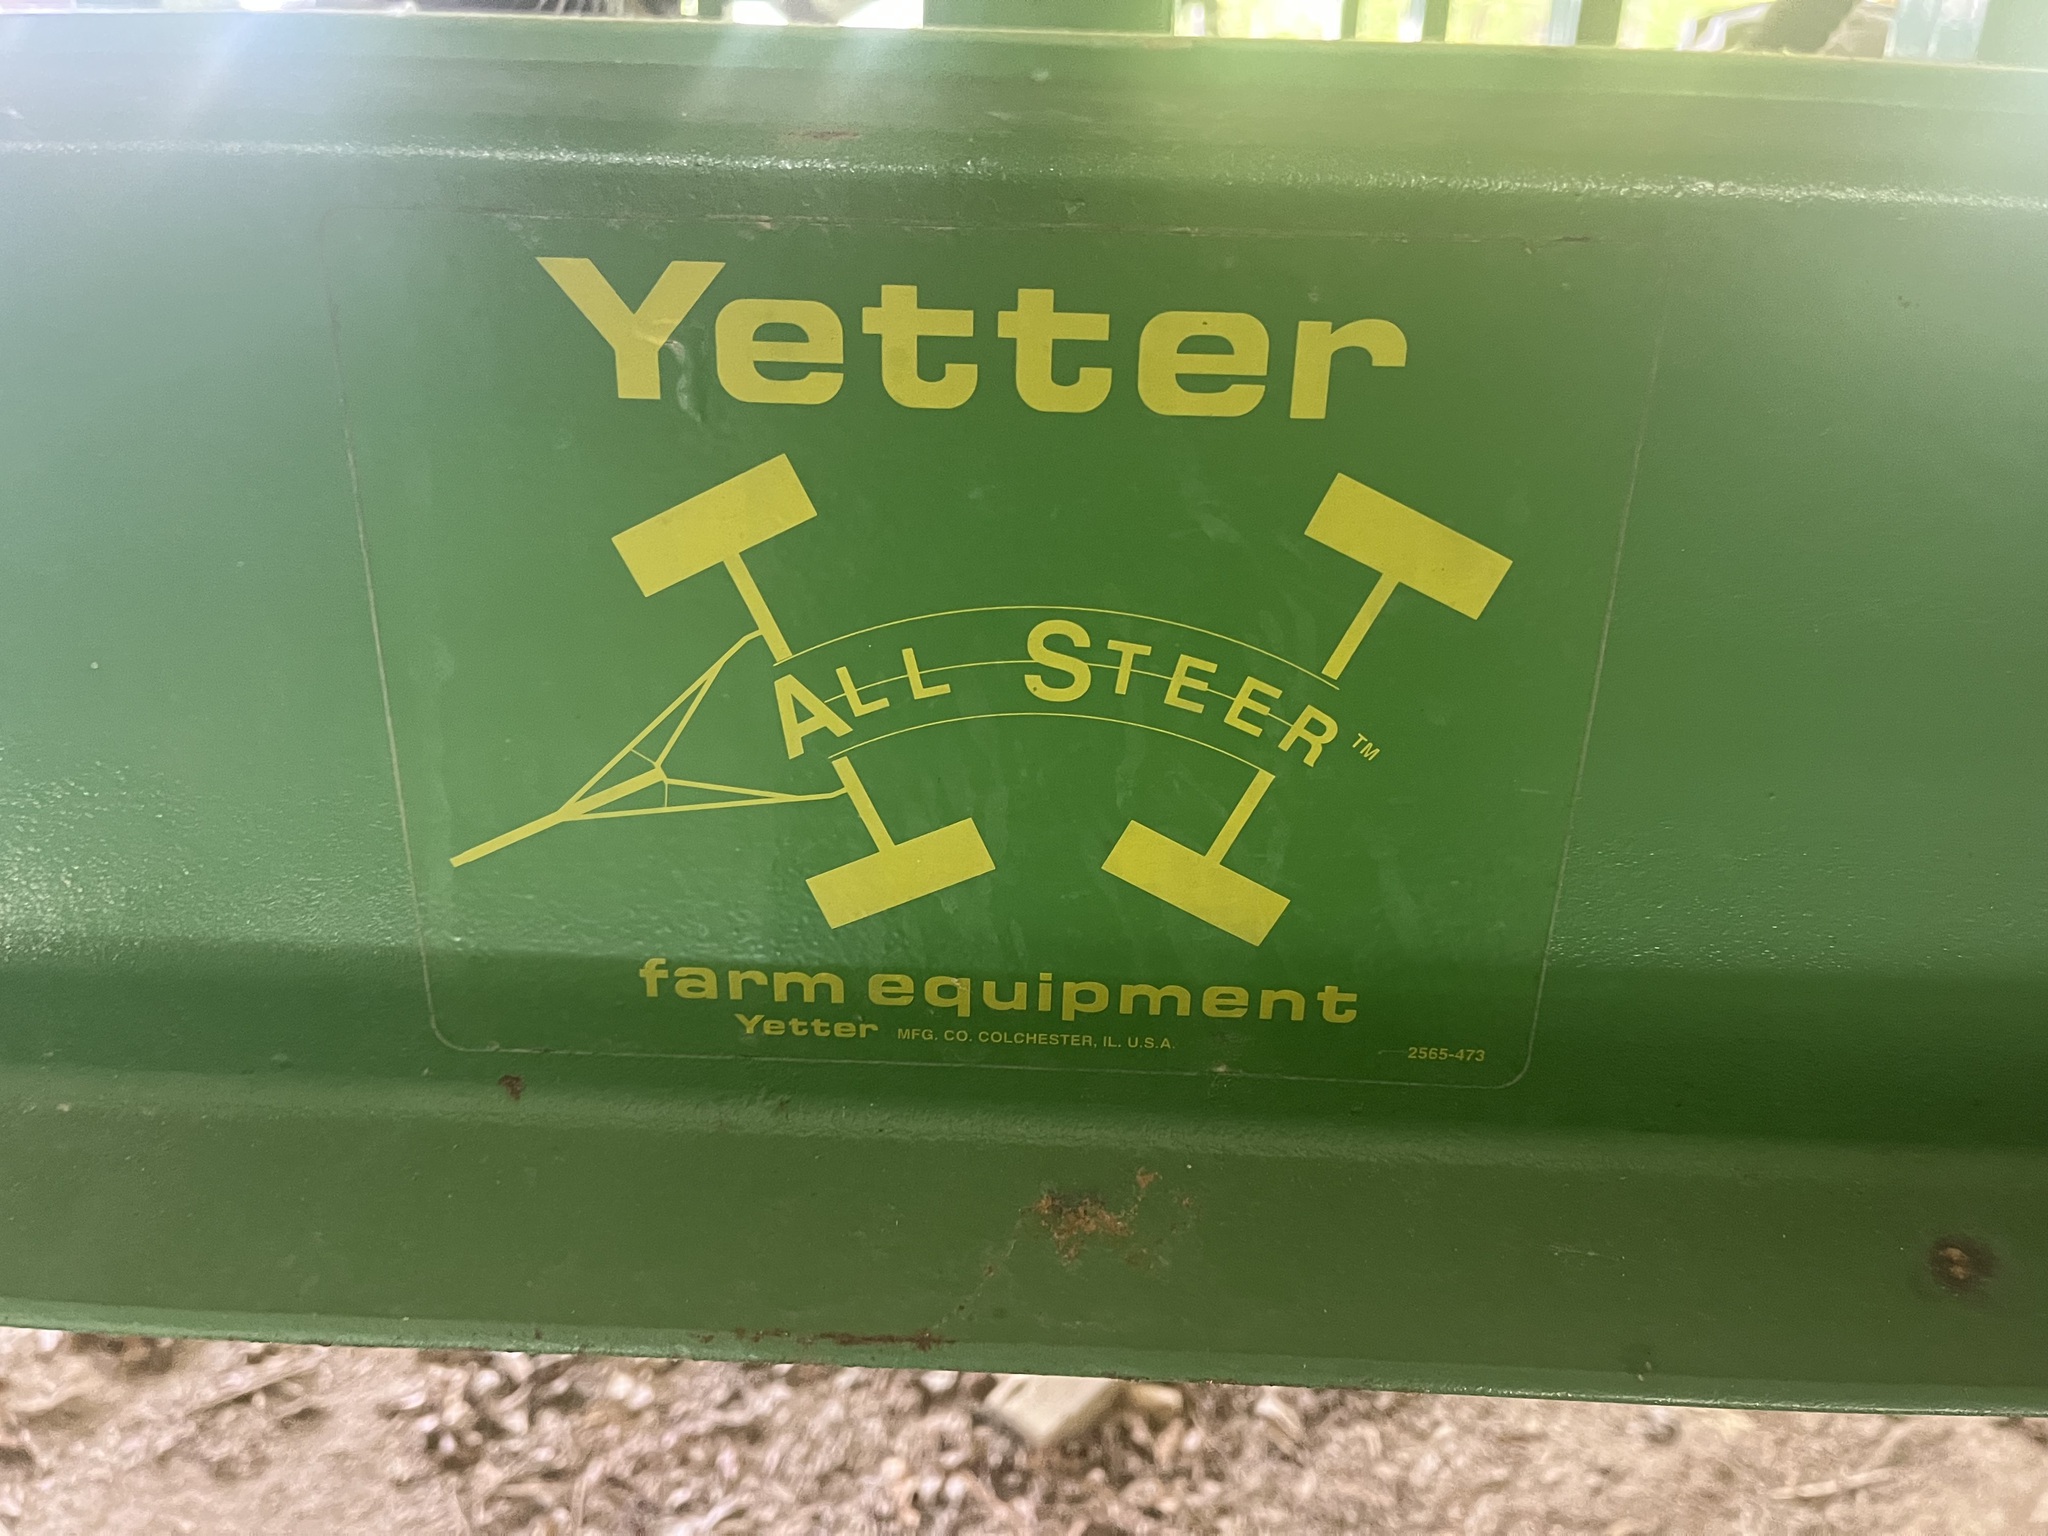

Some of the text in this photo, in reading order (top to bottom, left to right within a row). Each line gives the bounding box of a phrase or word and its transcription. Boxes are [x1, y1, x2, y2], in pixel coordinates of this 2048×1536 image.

[535, 256, 1409, 420] Yetter
[773, 647, 952, 760] ALL
[1023, 619, 1340, 768] STEER
[638, 957, 1360, 1025] farm equipment
[734, 1013, 1176, 1049] Yetter MFG. CO. COLCHESTER, IL. U.S.A.
[1407, 1046, 1486, 1062] 2565-473
